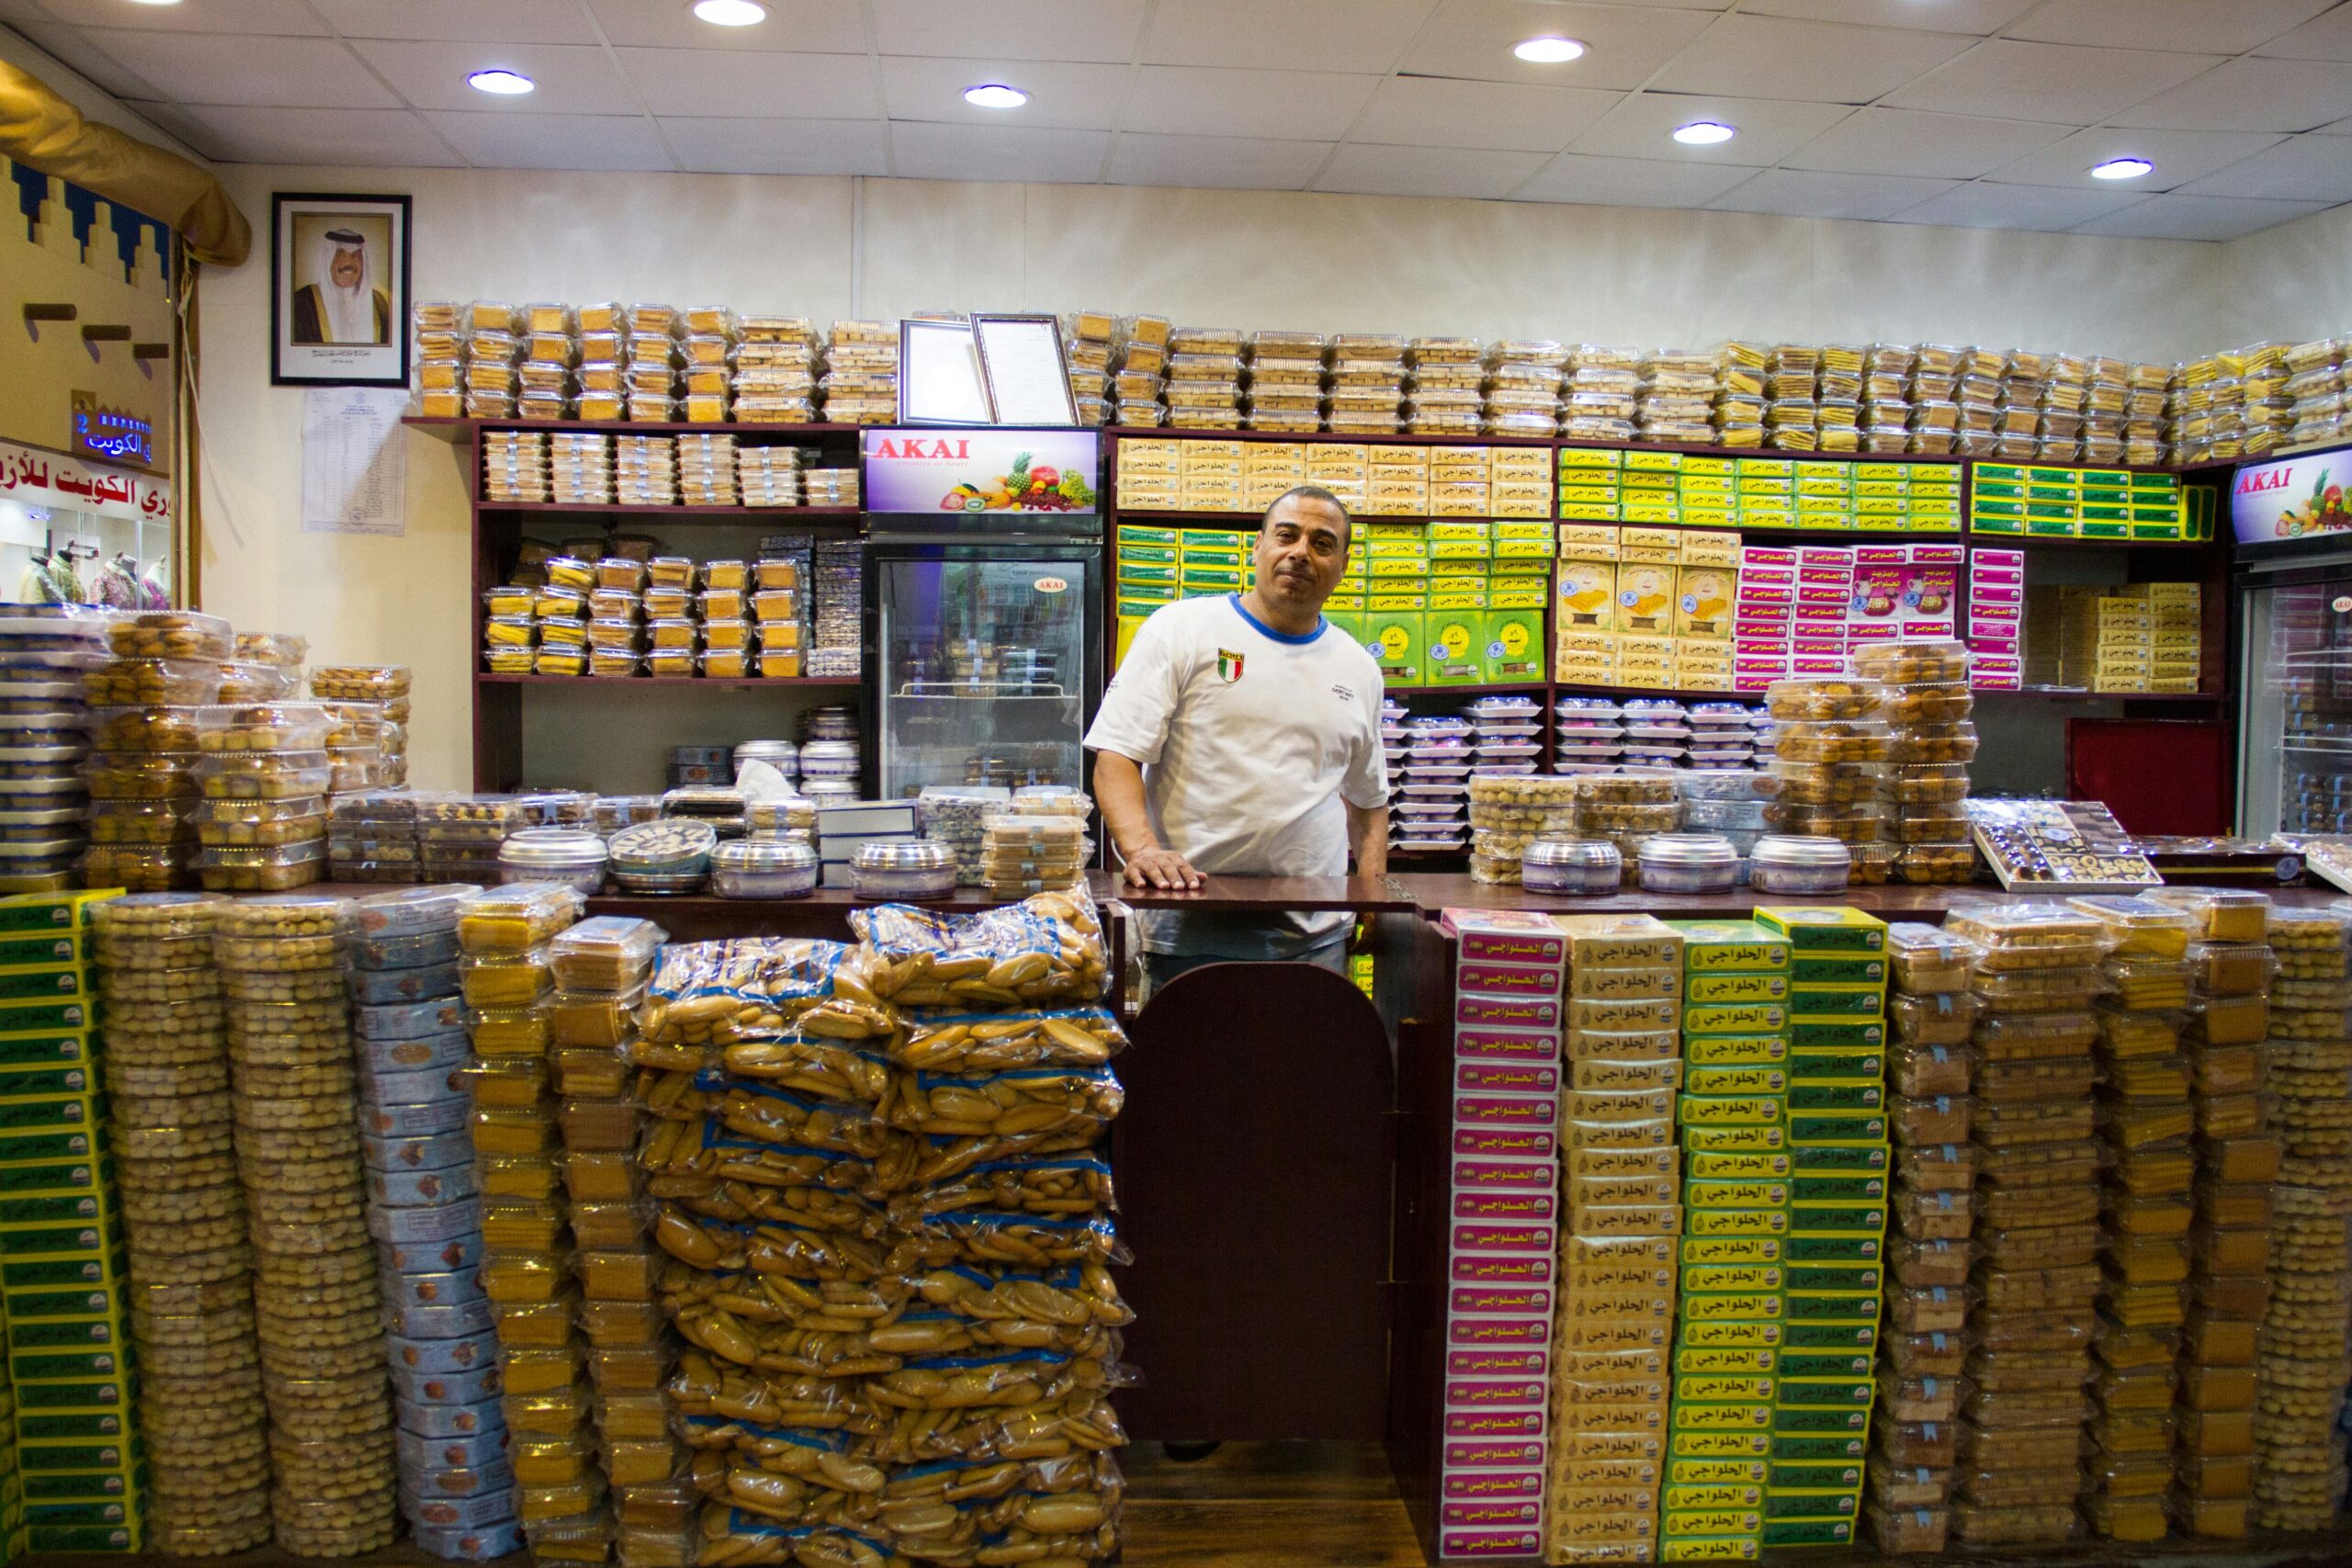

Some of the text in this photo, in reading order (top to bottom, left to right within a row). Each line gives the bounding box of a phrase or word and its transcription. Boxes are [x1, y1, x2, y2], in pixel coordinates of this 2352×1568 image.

[873, 437, 970, 459] AKAI
[55, 470, 136, 504] الكويت
[2236, 468, 2293, 494] AKAI
